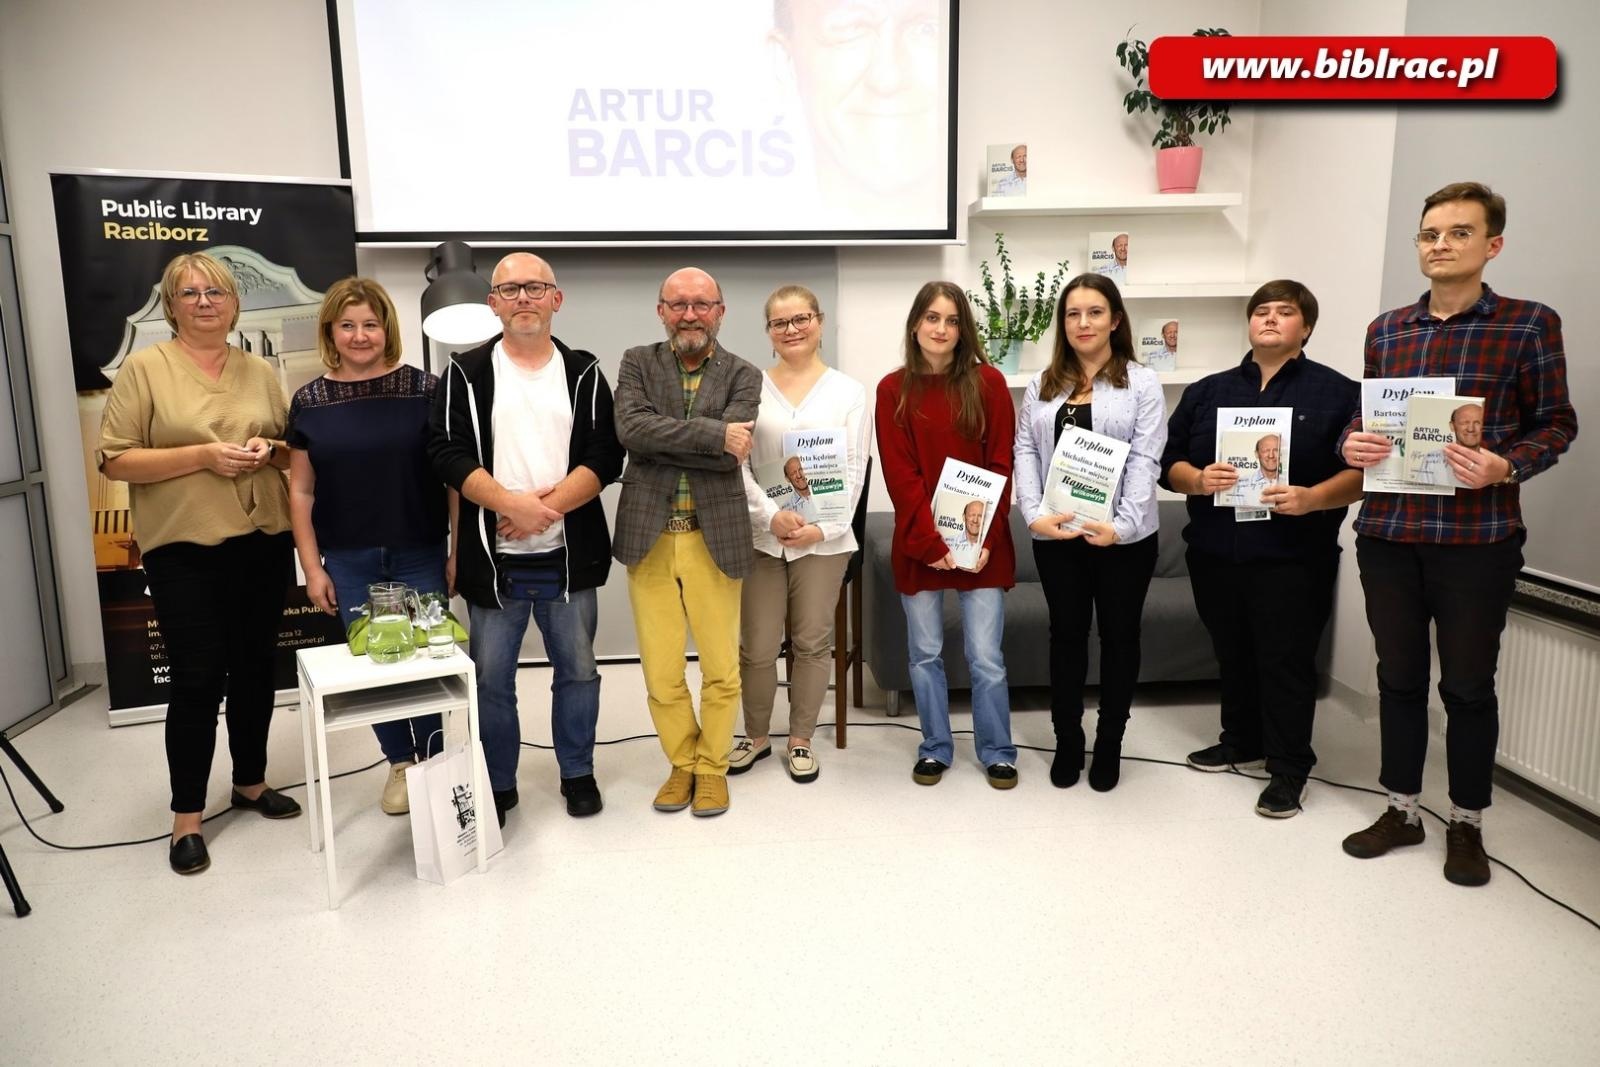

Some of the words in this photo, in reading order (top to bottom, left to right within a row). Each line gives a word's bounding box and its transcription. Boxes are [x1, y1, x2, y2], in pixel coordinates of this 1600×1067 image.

[567, 87, 715, 123] ARTUR
[566, 114, 796, 178] BARCIŚ
[101, 199, 177, 219] Public
[182, 200, 263, 226] Library
[103, 221, 209, 242] Raciborz
[1233, 415, 1277, 427] Dyplom
[1373, 410, 1407, 418] Bartosz
[1413, 426, 1440, 434] ARTUR
[797, 435, 835, 449] Dyplom
[1412, 432, 1454, 444] BARCIŚ
[1073, 435, 1115, 457] Dyplom
[956, 469, 993, 489] Dyplom
[937, 519, 964, 532] BARCIŚ
[938, 515, 957, 523] ARTUR
